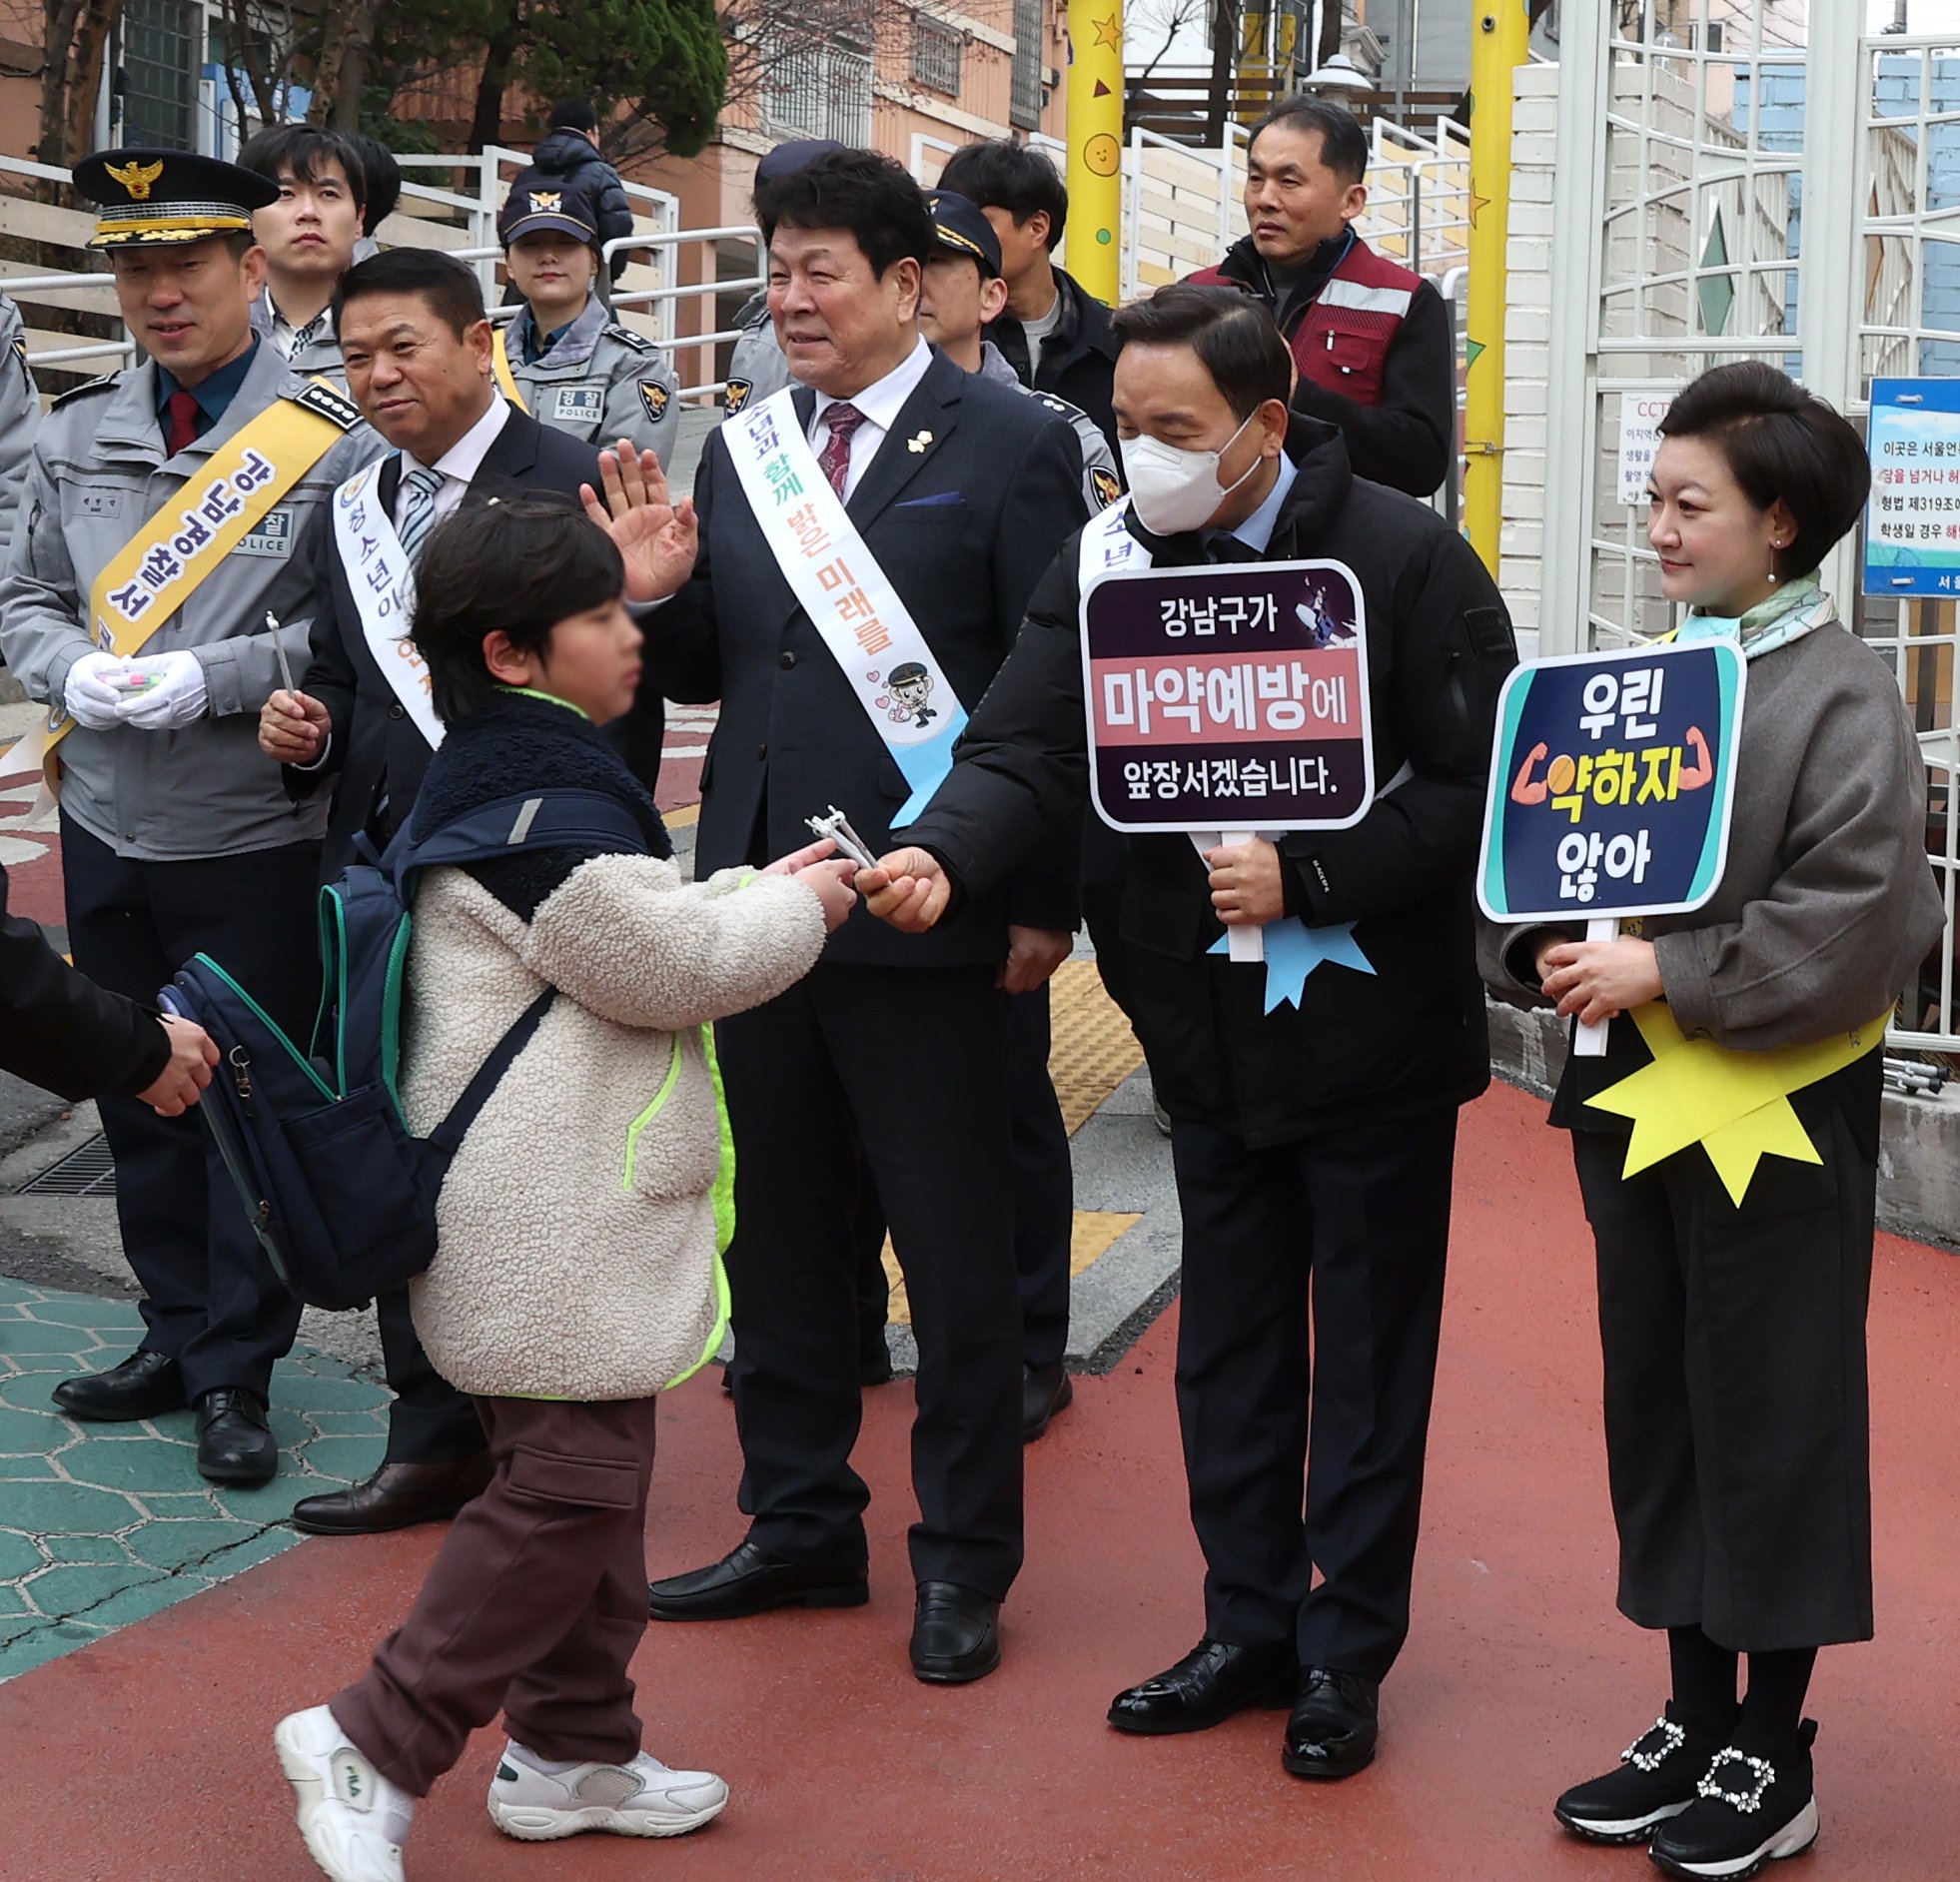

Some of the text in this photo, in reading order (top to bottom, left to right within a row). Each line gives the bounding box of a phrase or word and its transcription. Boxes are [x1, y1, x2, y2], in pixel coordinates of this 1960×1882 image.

[559, 408, 598, 419] POLICE
[562, 392, 599, 408] 경찰
[1883, 441, 1960, 458] 이곳은 서울언
[1909, 469, 1944, 484] 넘거나
[1881, 495, 1904, 512] 형법
[109, 451, 273, 619] 강남경찰서
[1880, 522, 1960, 539] 학생일 경우 해
[349, 499, 402, 617] 청소년이
[762, 453, 805, 506] 함께
[786, 501, 832, 559] 밝은
[815, 556, 893, 656] 미래를
[1160, 593, 1279, 637] 강남구가
[1102, 661, 1348, 735] 마약예방에
[1578, 667, 1664, 740] 우린
[1123, 755, 1339, 800] 앞장서겠습니다.
[1547, 745, 1683, 824] 약하지
[1555, 828, 1652, 903] 않아
